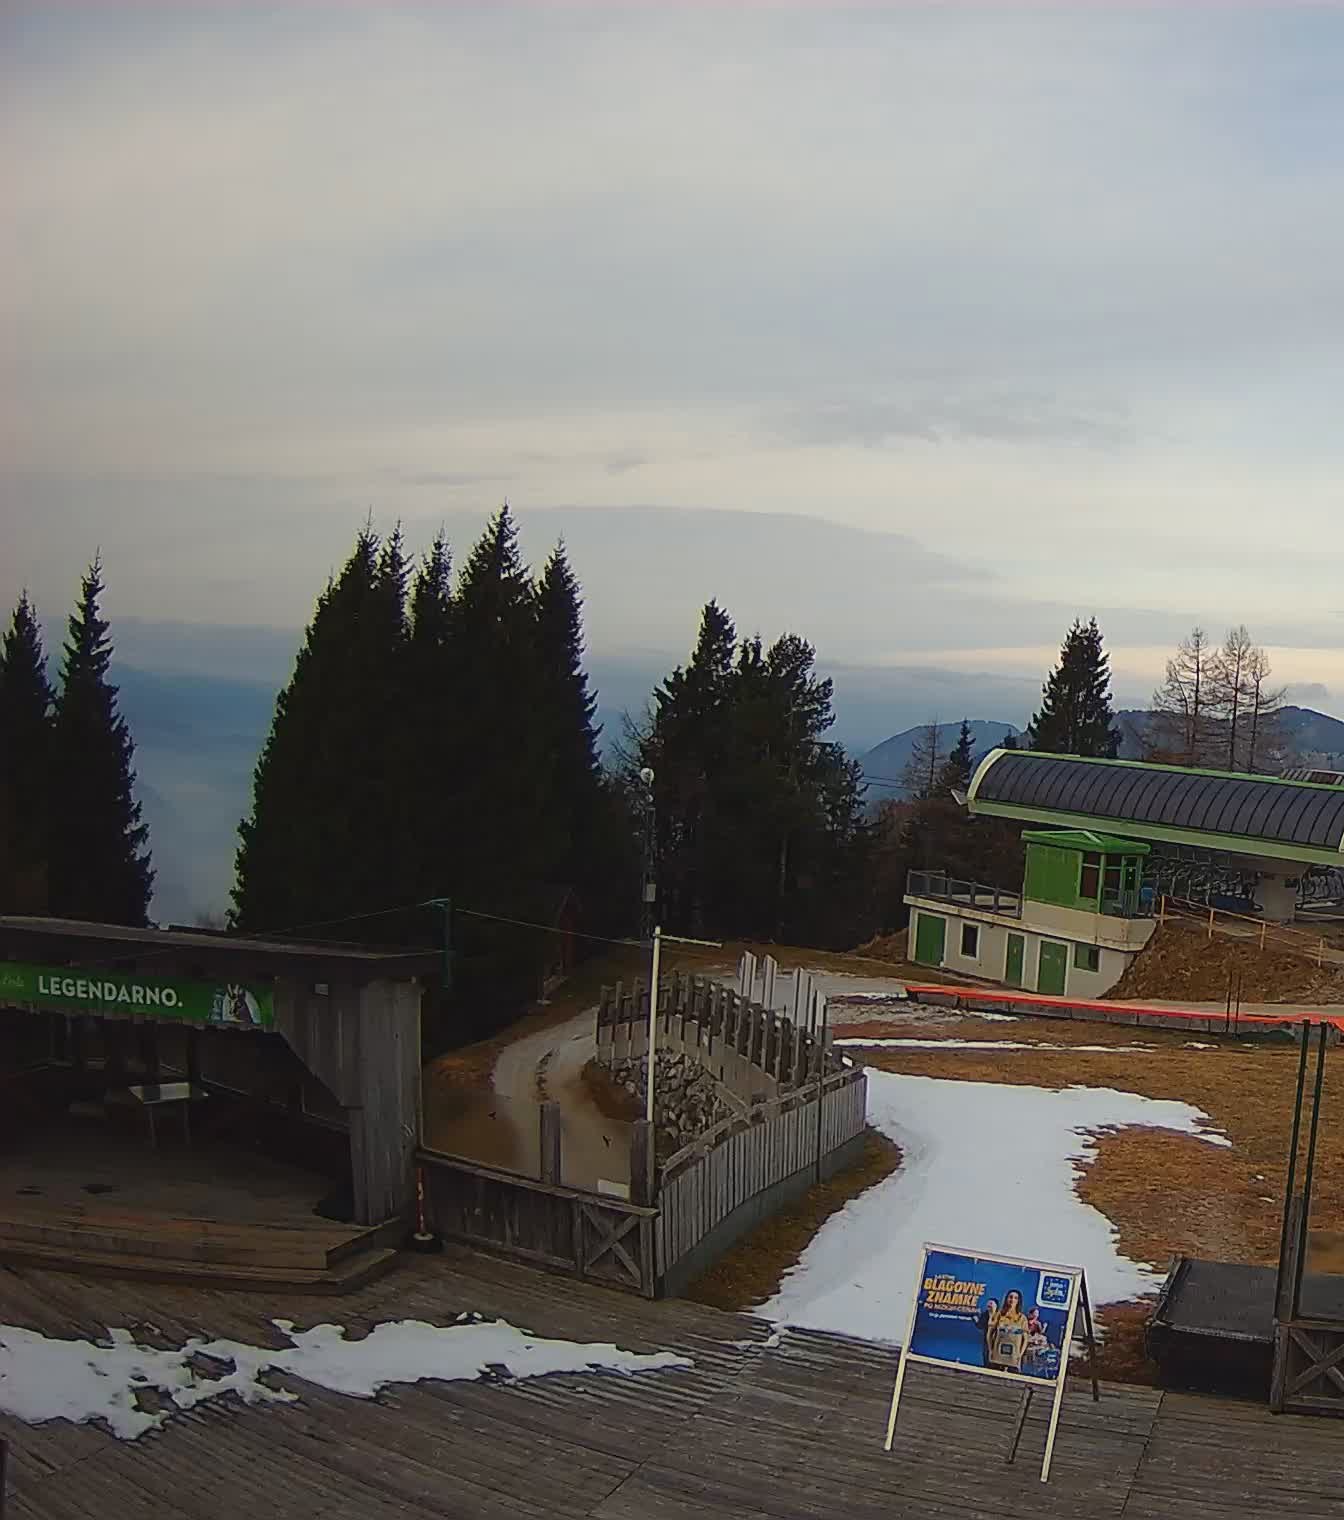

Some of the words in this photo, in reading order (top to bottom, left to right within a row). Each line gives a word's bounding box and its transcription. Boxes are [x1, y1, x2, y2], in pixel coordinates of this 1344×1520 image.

[38, 975, 183, 1007] LEGENDARNO.
[924, 1278, 986, 1295] BLAGOVNE
[927, 1291, 979, 1306] ZNAMKE
